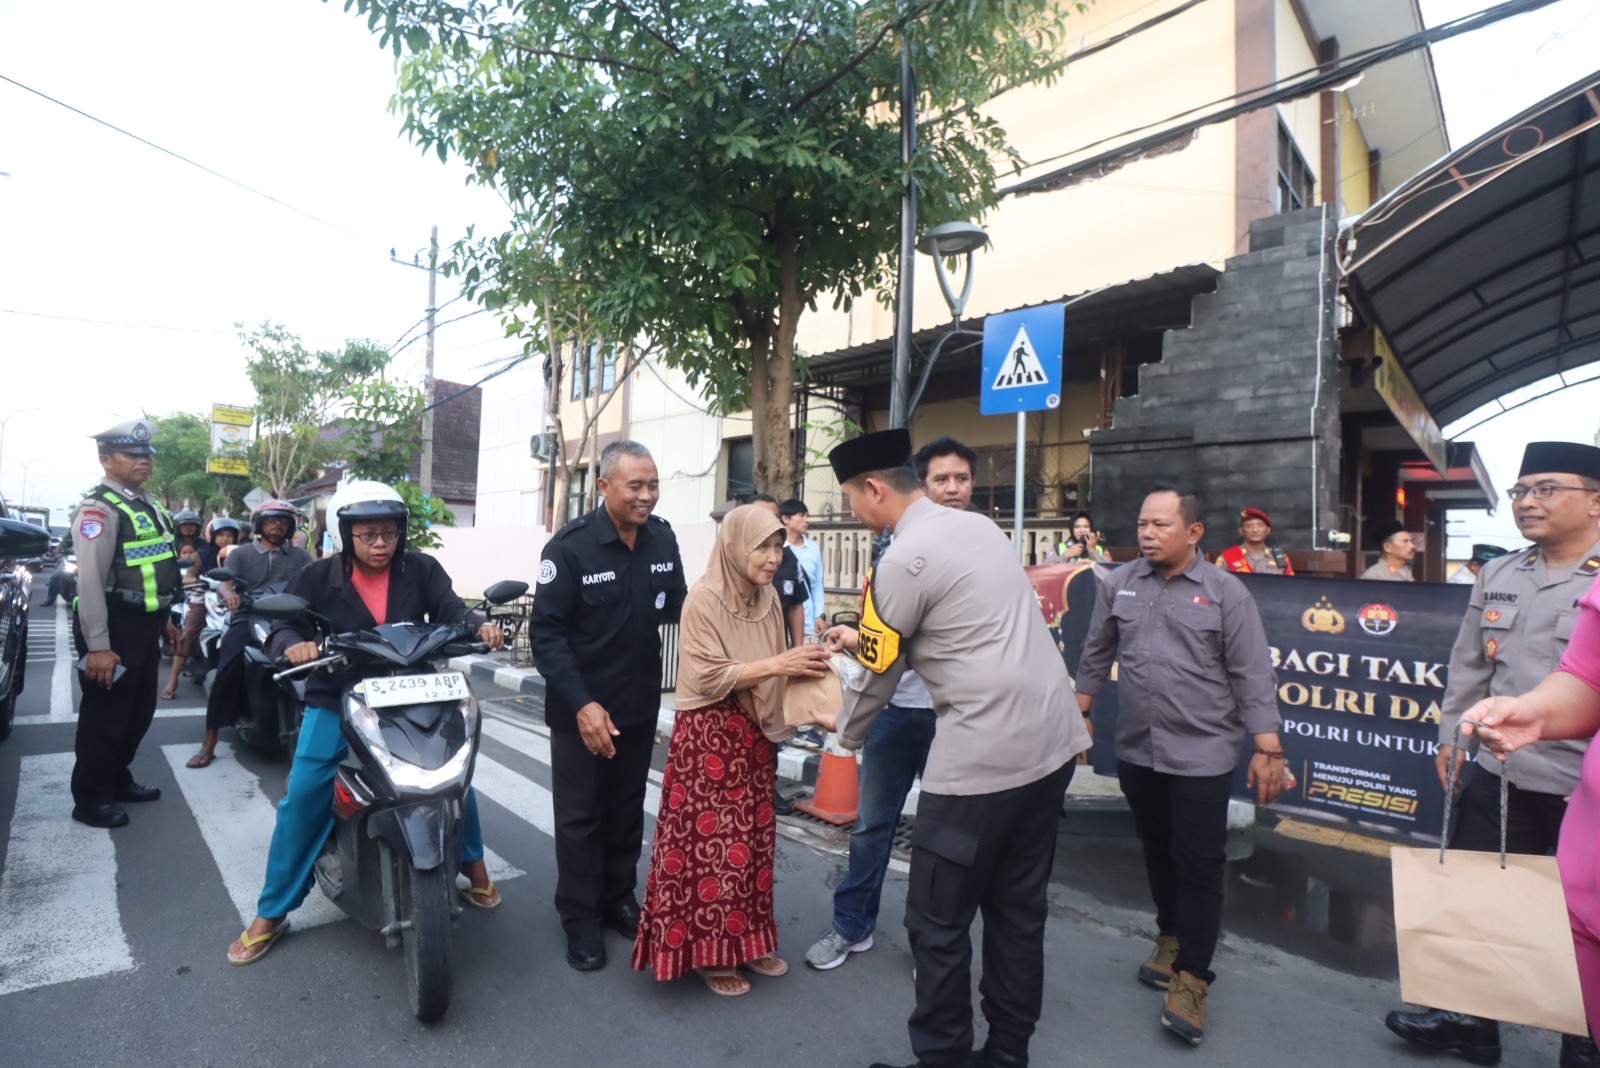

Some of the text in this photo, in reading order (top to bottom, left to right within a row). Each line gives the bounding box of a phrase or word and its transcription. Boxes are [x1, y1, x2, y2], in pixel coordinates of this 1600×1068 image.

[582, 571, 616, 585] KARYOTO
[651, 562, 673, 574] POLRI
[370, 675, 460, 692] S 2439 ABP
[1361, 655, 1450, 688] TAK
[1274, 682, 1377, 716] OLRI
[1283, 719, 1349, 742] POLRI
[1356, 730, 1442, 757] UNTUK
[1312, 761, 1391, 782] TRANSFORMASI
[1312, 771, 1418, 797] MENUJU POLRI YANG
[354, 772, 375, 798] HONDA
[1308, 781, 1419, 814] PRESISI
